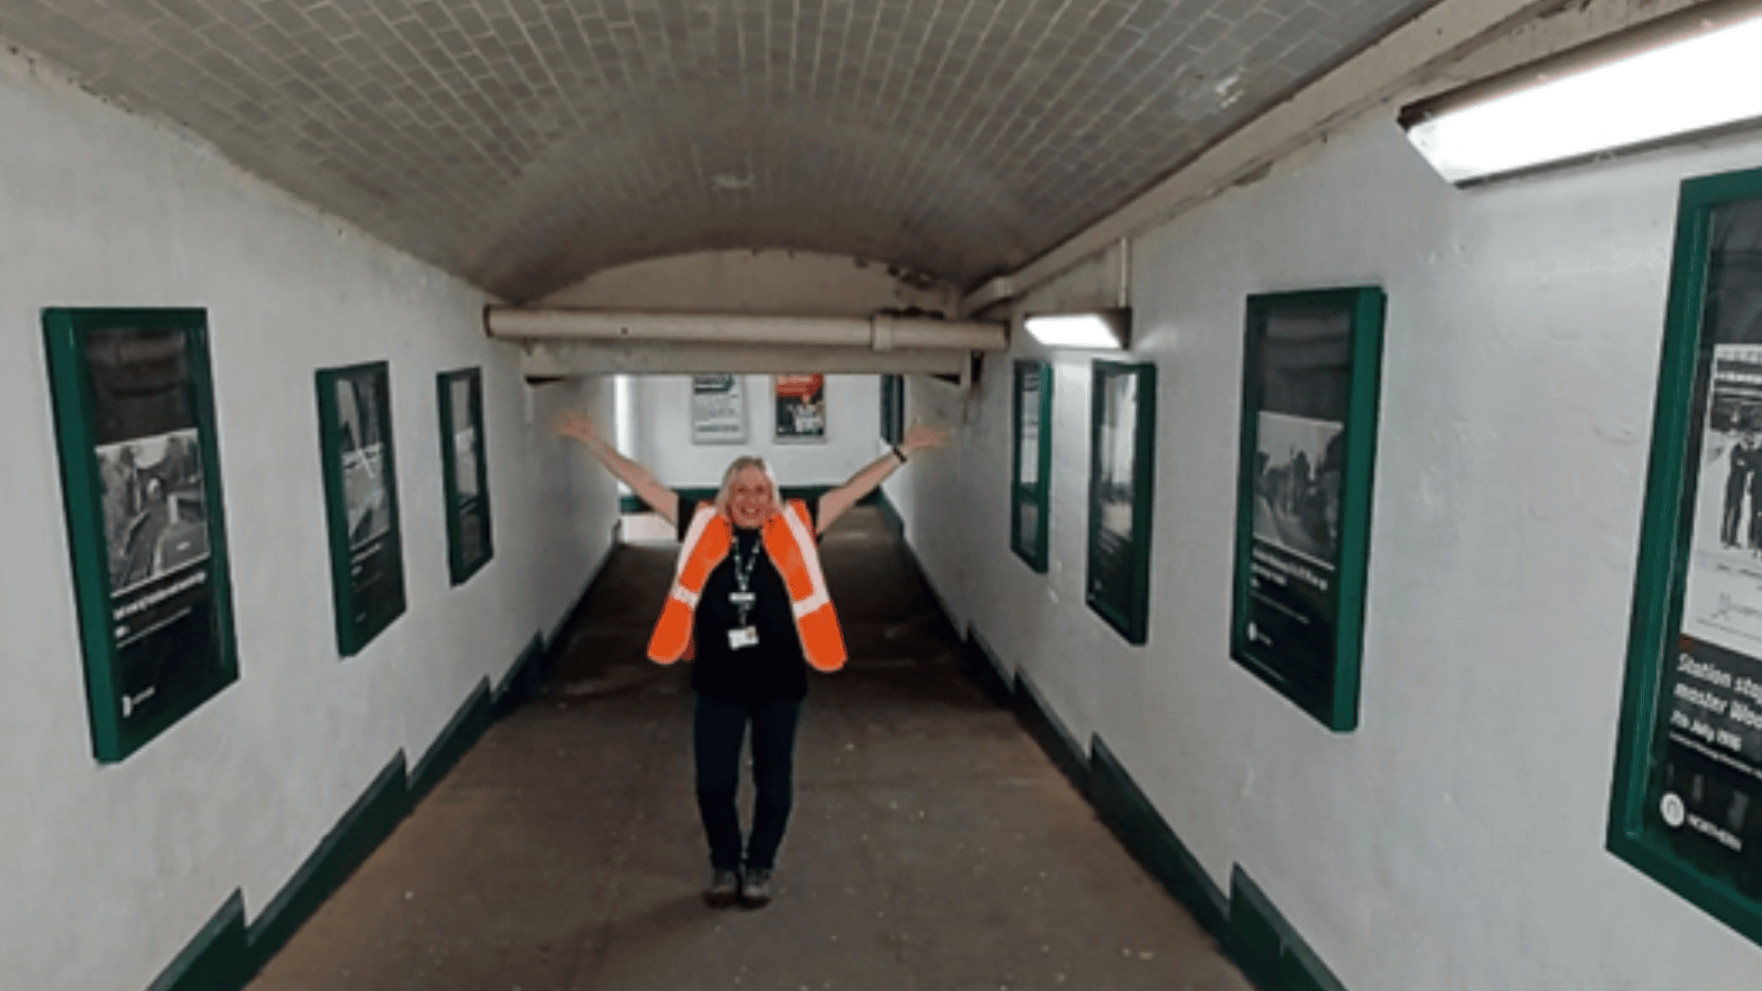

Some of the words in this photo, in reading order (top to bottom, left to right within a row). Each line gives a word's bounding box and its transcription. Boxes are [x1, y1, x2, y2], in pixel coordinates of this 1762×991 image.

[1677, 652, 1731, 688] Station
[1674, 683, 1728, 715] master
[1687, 811, 1742, 853] NORTHERN
